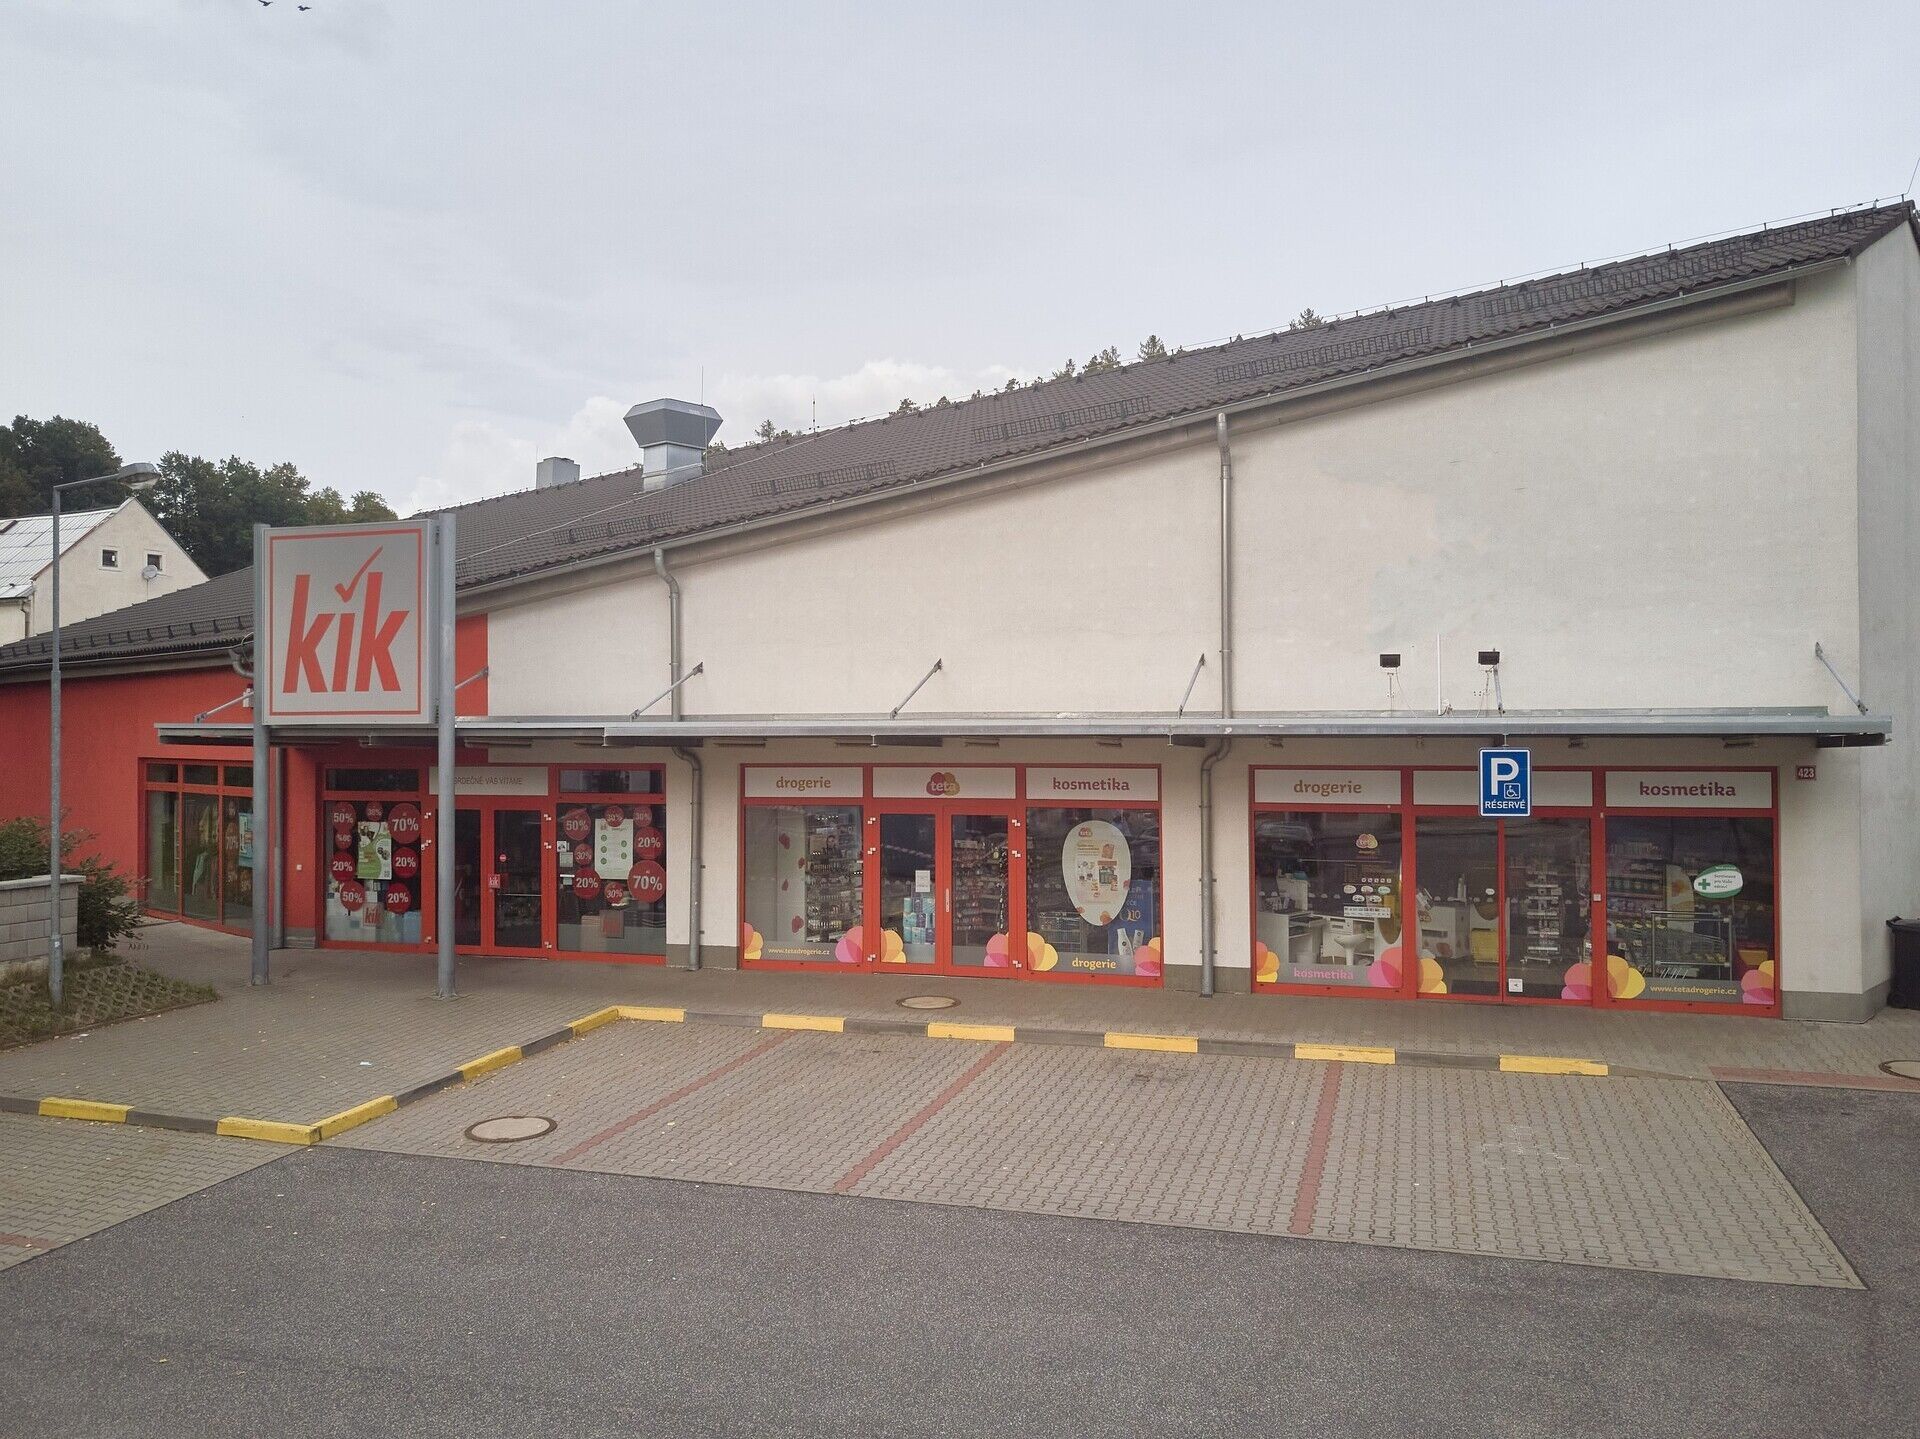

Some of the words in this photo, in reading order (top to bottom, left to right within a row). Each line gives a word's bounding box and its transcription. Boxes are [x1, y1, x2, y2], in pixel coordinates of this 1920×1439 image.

[282, 549, 410, 693] kik
[1491, 757, 1519, 796] P
[1797, 768, 1815, 778] 423
[776, 776, 832, 792] drogerie
[930, 781, 956, 792] teta
[1053, 777, 1130, 791] kosmetika
[1294, 780, 1362, 797] drogerie
[1639, 781, 1737, 797] kosmetika
[1485, 799, 1526, 809] RÉSERVÉ
[333, 812, 354, 824] 50%
[392, 818, 419, 832] 70%
[566, 820, 589, 831] 50%
[638, 837, 661, 848] 20%
[332, 861, 353, 872] 20%
[395, 857, 416, 868] 20%
[576, 878, 599, 888] 20%
[633, 876, 663, 890] 70%
[343, 892, 363, 903] 50%
[387, 893, 409, 904] 20%
[1071, 957, 1117, 971] drogerie
[1293, 967, 1353, 980] kosmetika
[1649, 985, 1737, 996] www.tetadrogerie.cz
